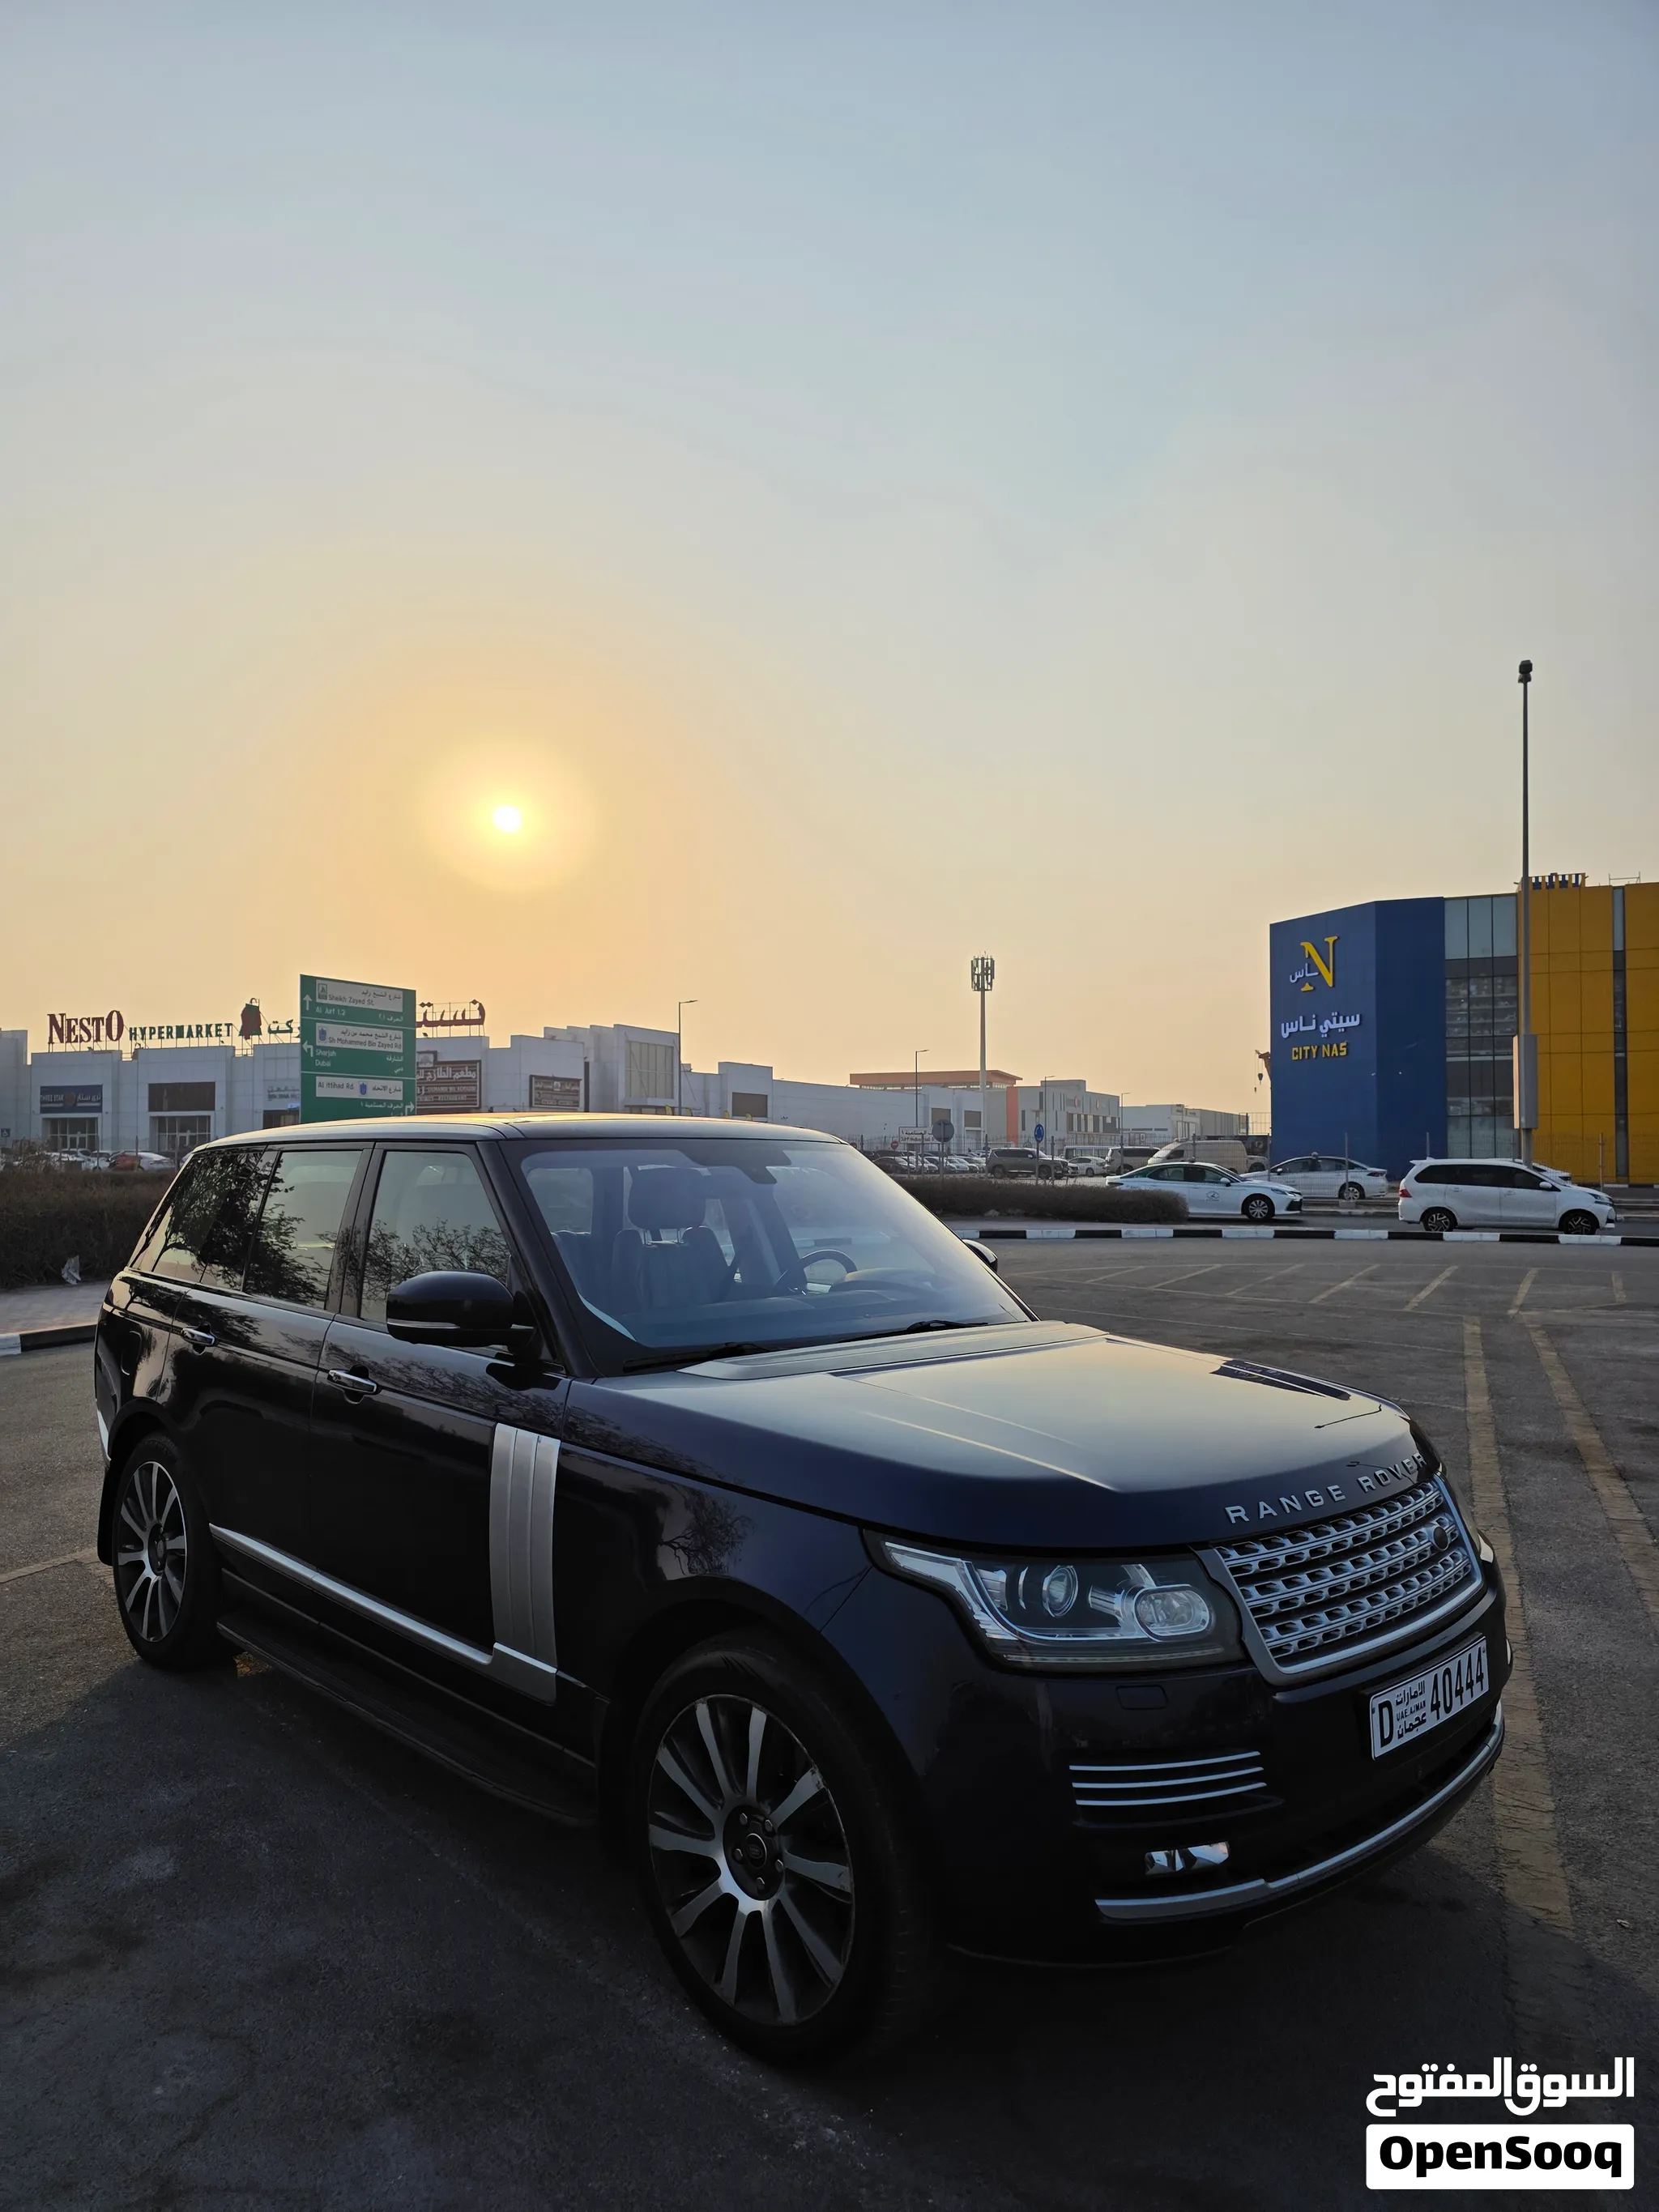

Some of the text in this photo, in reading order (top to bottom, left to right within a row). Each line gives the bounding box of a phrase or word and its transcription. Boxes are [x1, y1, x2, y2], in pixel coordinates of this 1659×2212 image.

[328, 995, 347, 1003] Sheikh
[348, 996, 365, 1005] Zayed
[129, 1023, 233, 1041] HYPERMARKET
[1281, 1012, 1361, 1038] سيتي ناس
[315, 1049, 336, 1058] Sharjah
[336, 1037, 367, 1046] Mohammed
[377, 1041, 394, 1049] Zayed
[1292, 1042, 1348, 1060] CITY NAS
[1224, 1452, 1427, 1524] RANGE ROVER
[1430, 1646, 1484, 1720] 40444
[1378, 1699, 1394, 1749] D
[1397, 1712, 1427, 1740] عجمان
